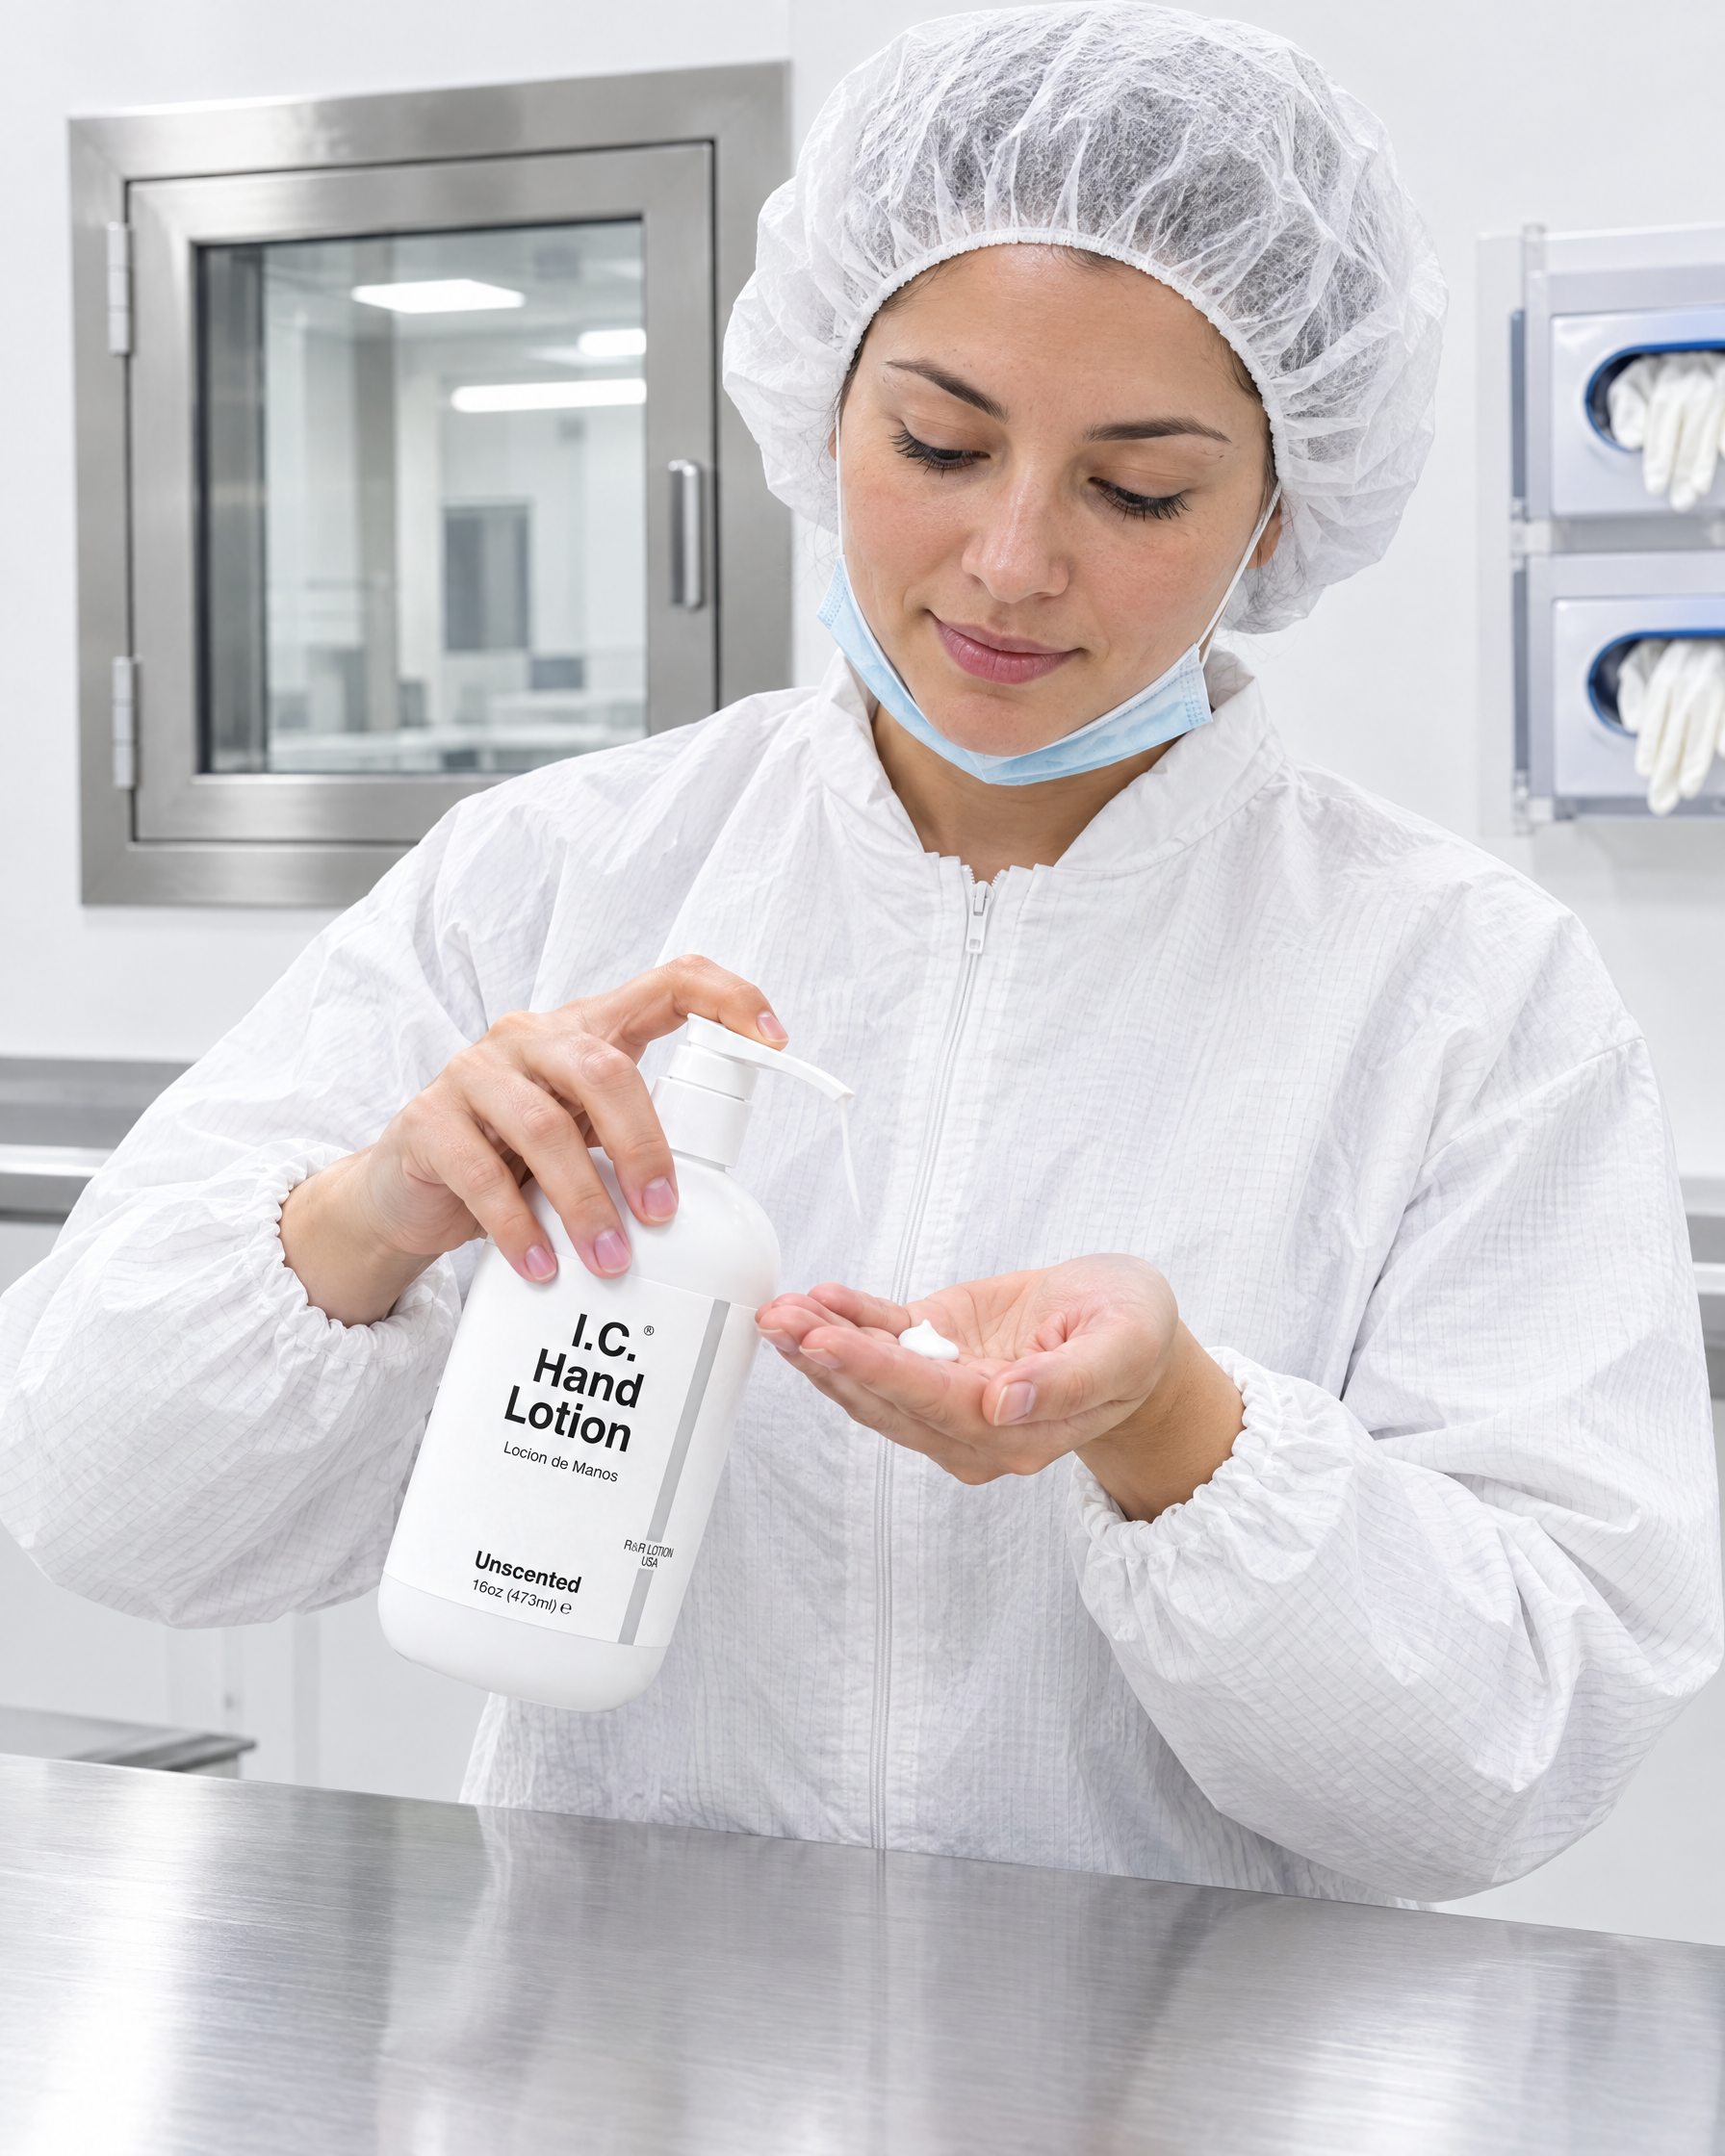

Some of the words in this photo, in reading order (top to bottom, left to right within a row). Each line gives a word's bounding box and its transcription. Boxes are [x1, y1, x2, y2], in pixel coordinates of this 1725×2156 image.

[571, 1312, 636, 1363] I.C.
[532, 1347, 646, 1409] Hand
[503, 1384, 631, 1453] Lotion
[502, 1441, 548, 1465] Locion
[551, 1455, 569, 1471] de
[572, 1460, 619, 1482] Manos
[623, 1539, 647, 1554] R&R
[646, 1544, 675, 1558] LOTION
[640, 1555, 658, 1569] USA
[475, 1550, 582, 1594] Unscented
[473, 1578, 504, 1599] 16oz
[506, 1587, 557, 1615] (473ml)
